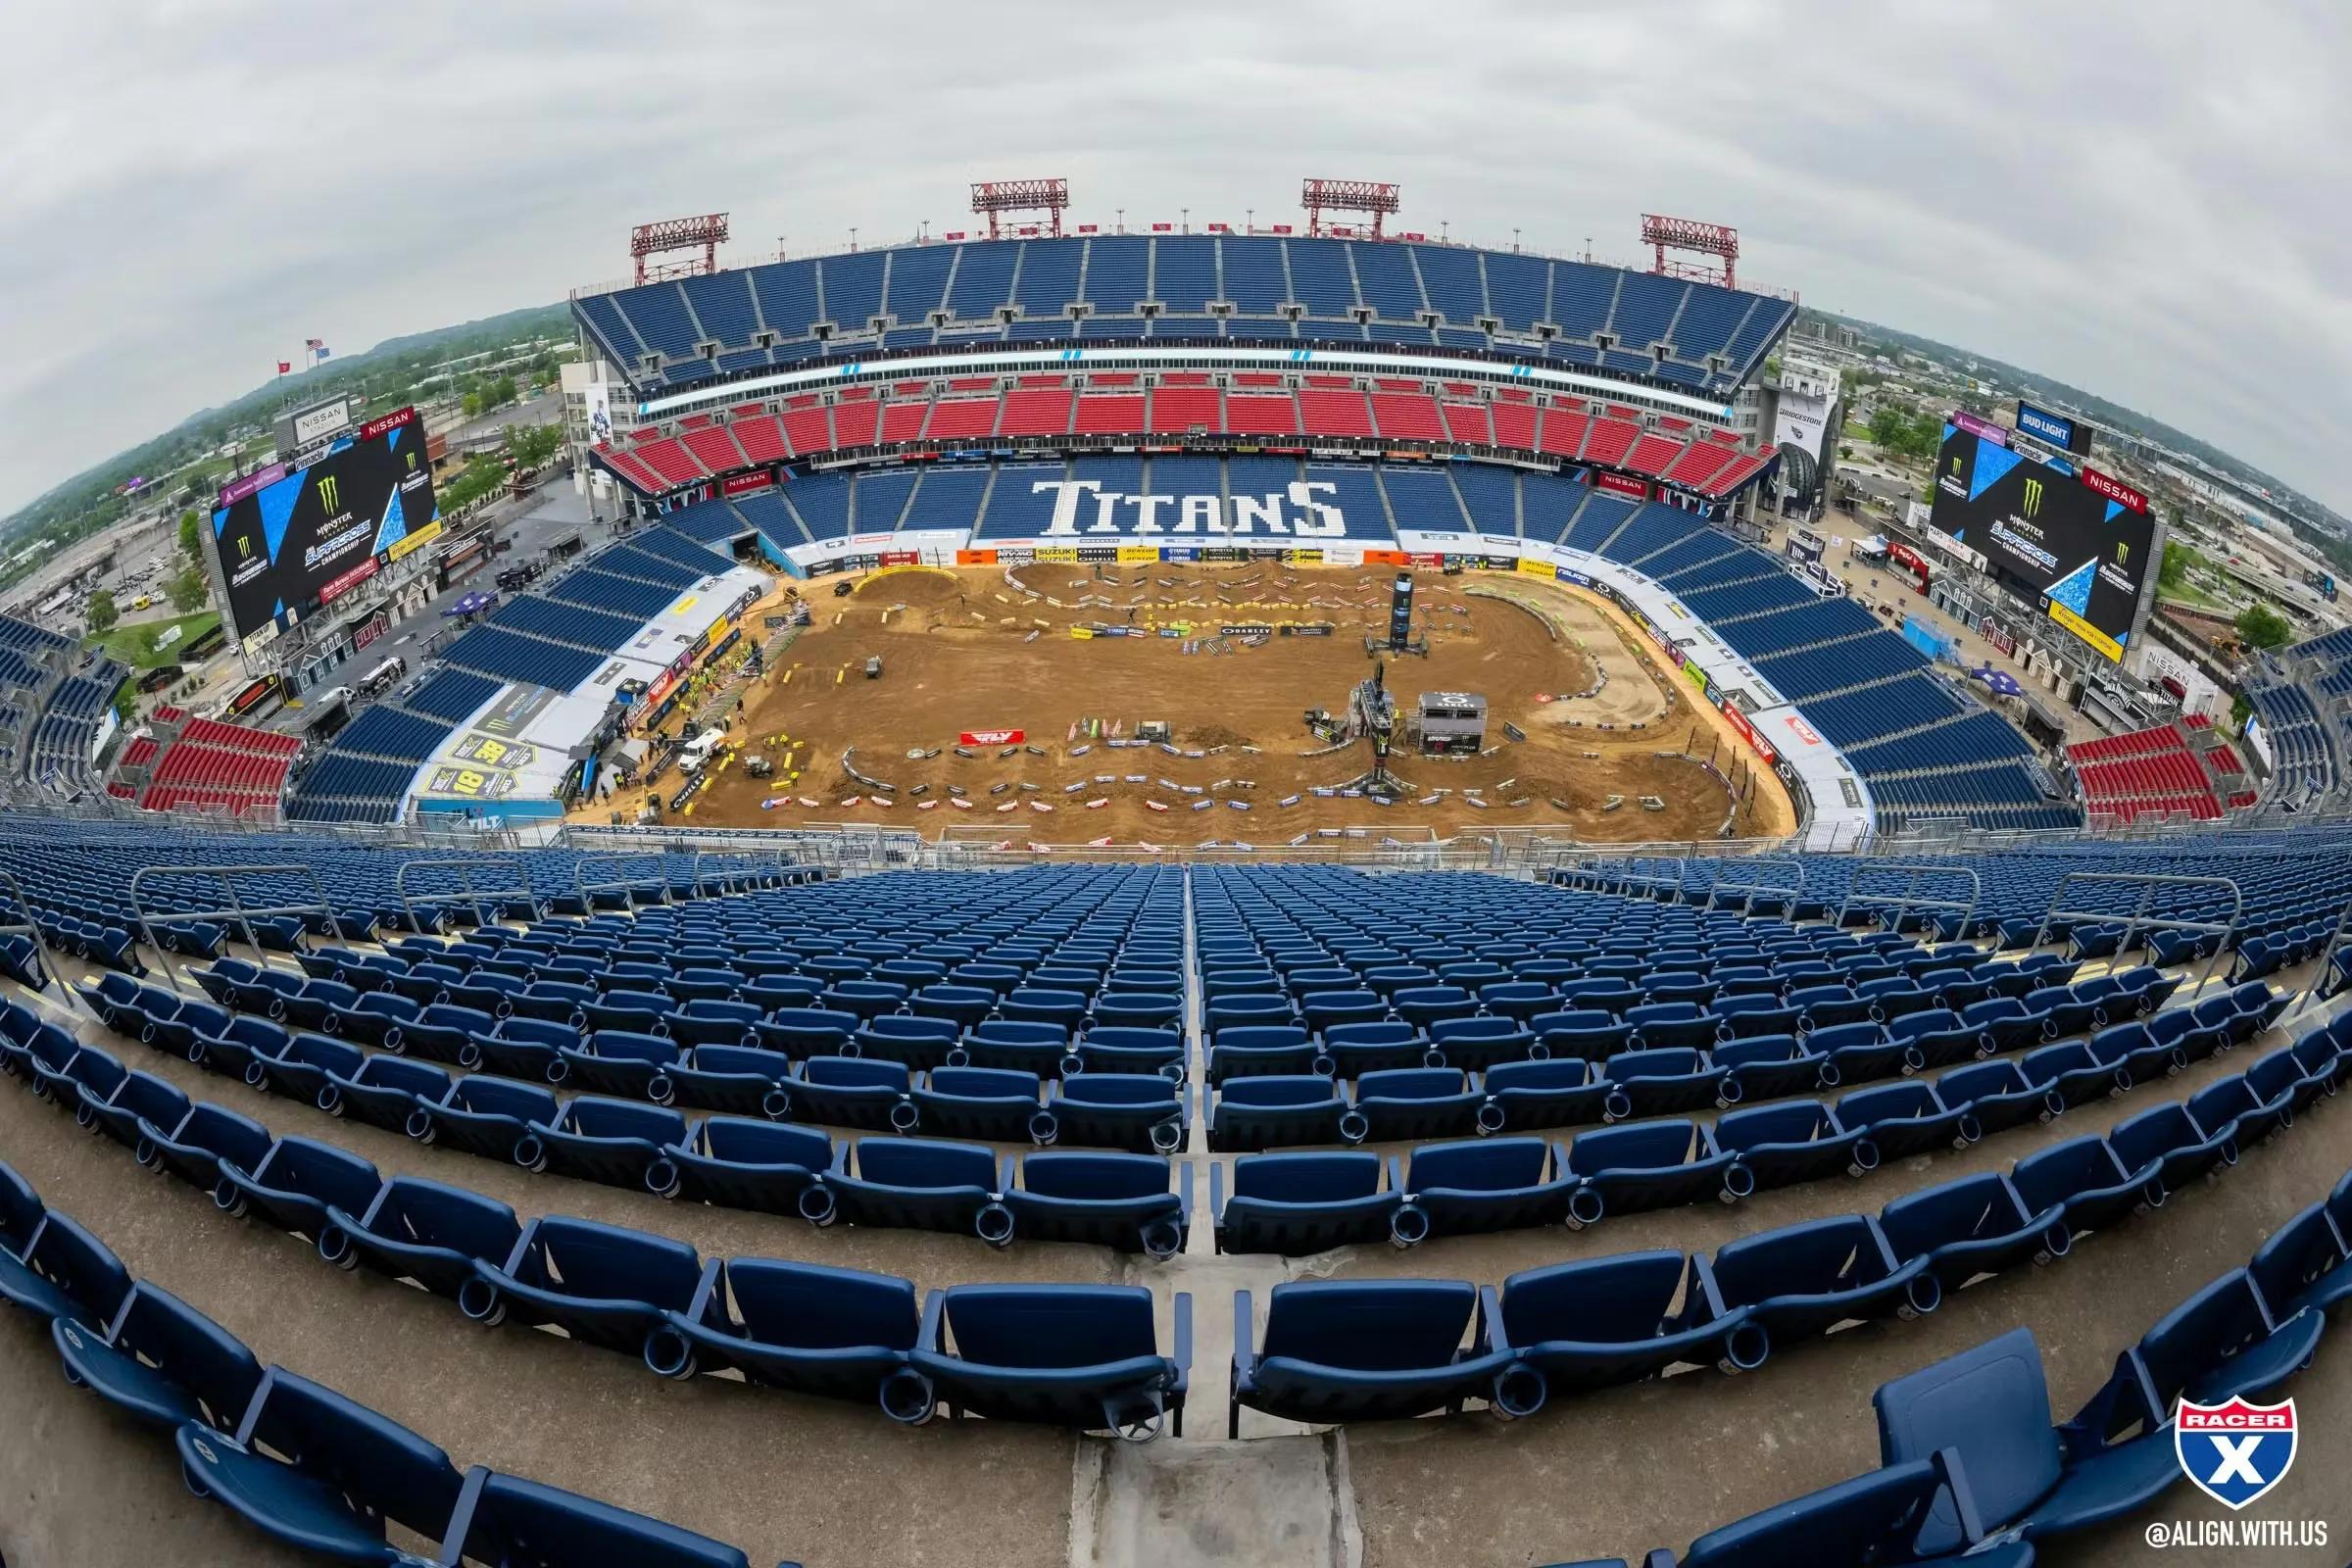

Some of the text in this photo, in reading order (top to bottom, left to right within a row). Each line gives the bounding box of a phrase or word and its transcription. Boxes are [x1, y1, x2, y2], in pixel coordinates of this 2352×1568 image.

[302, 408, 342, 429] NISSAN
[368, 412, 410, 435] NISSAN
[1779, 408, 1823, 427] BRIDGESTONE
[2023, 414, 2069, 440] BUD LIGHT
[296, 449, 324, 470] Pinnacle
[2016, 442, 2042, 463] Pinnacle
[729, 473, 765, 487] NISSAN
[1605, 475, 1642, 490] NISSAN
[2090, 475, 2137, 507] NISSAN
[1032, 480, 1347, 536] TITANS
[317, 512, 353, 536] MONSTER
[2010, 514, 2044, 540] MONSTER
[305, 519, 371, 566] SUPERCROSS
[320, 539, 360, 565] CHAMPIONSHIP
[1989, 523, 2058, 568] SUPERCROSS
[2002, 542, 2040, 567] CHAMPIONSHIP
[1593, 587, 1612, 599] OAKLEY
[249, 623, 270, 643] TITAN UP
[2148, 652, 2189, 686] NISSAN
[2160, 689, 2179, 707] TITAN
[474, 739, 508, 764] 38
[453, 770, 484, 795] 18
